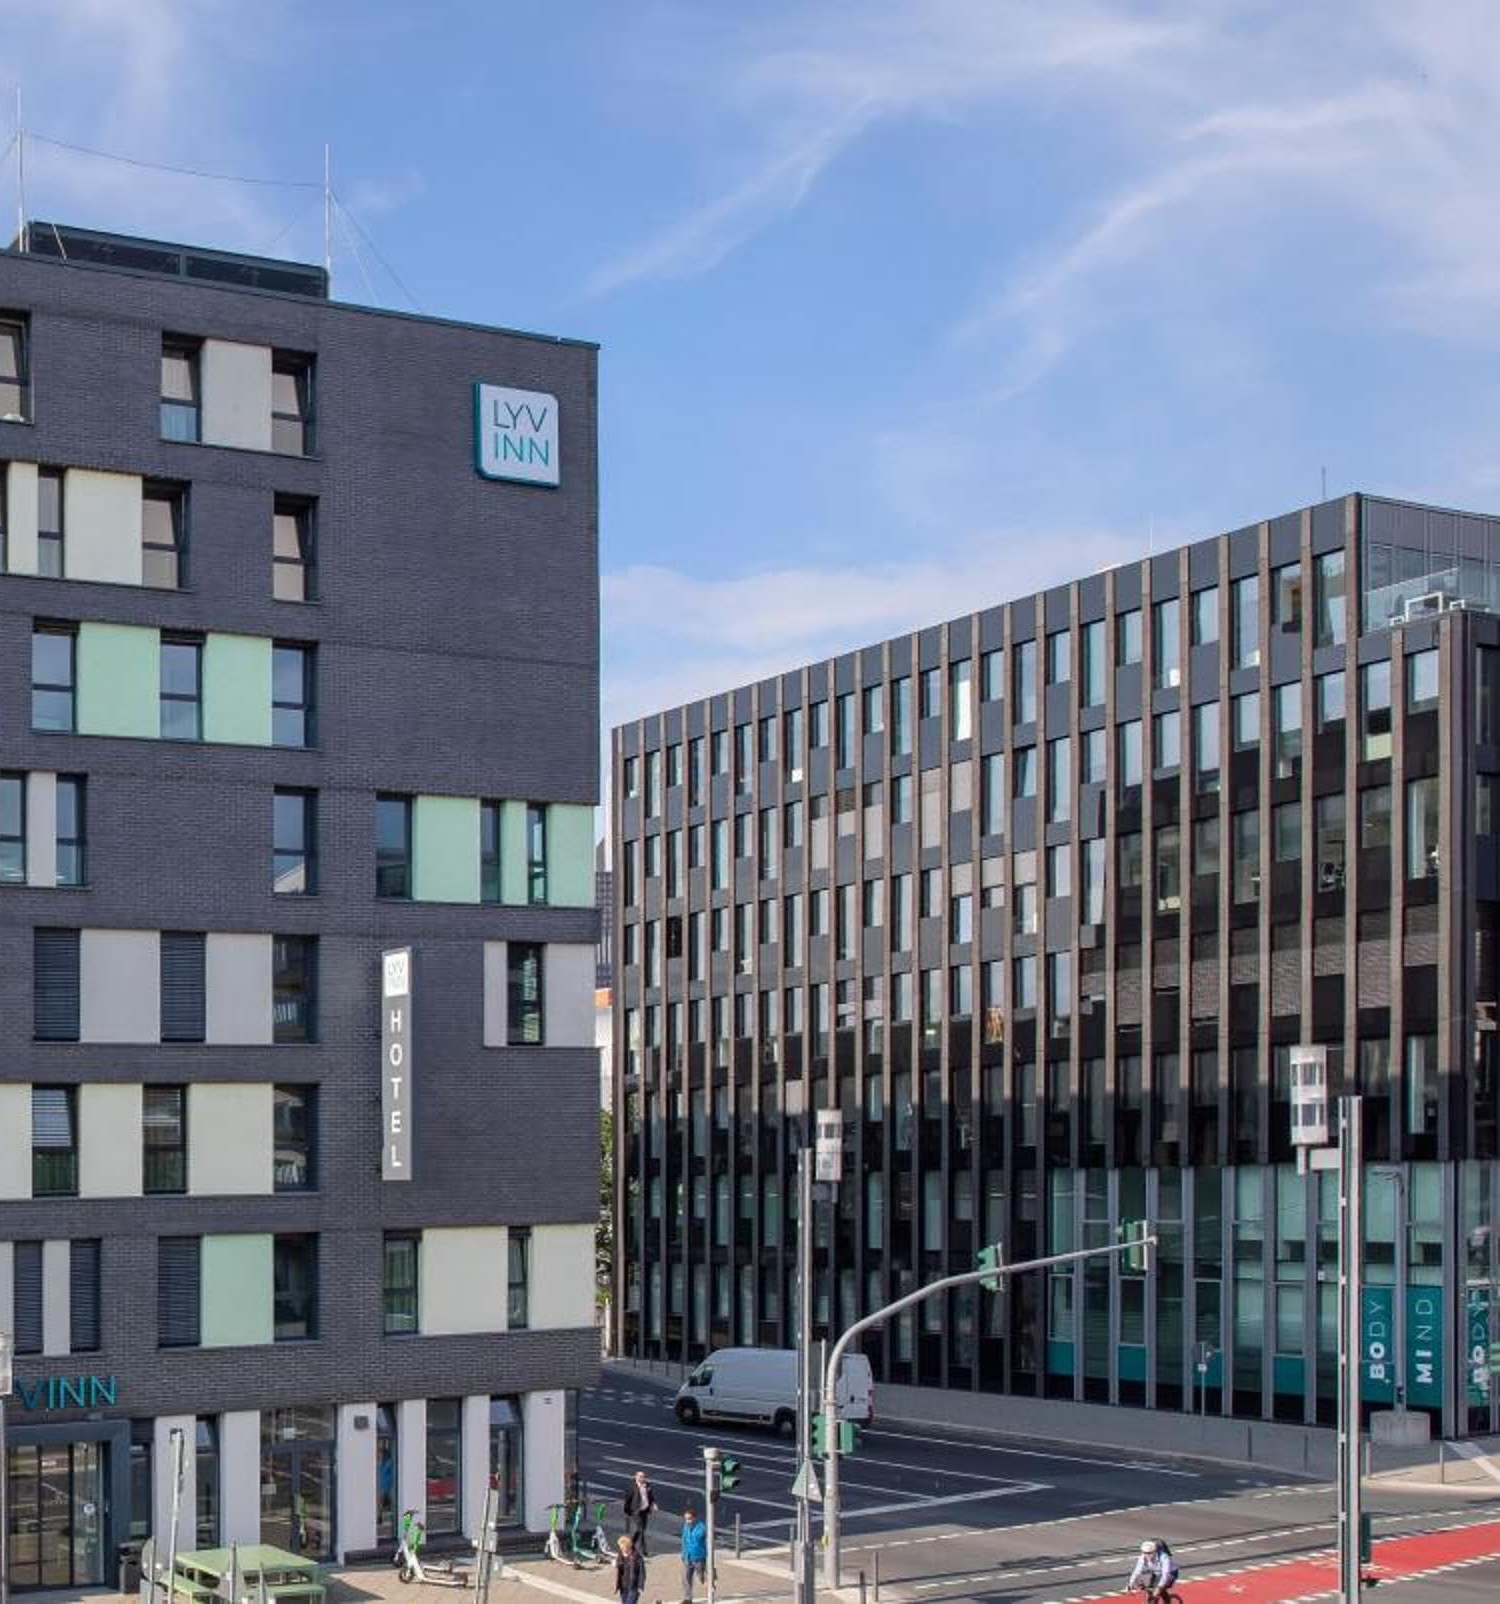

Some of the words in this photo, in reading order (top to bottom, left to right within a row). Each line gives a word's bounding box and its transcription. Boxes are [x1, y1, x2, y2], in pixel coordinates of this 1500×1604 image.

[493, 399, 547, 433] LYV
[494, 432, 548, 466] INN
[390, 1009, 403, 1168] HOTEL
[1369, 1301, 1385, 1380] BODY
[1415, 1299, 1433, 1384] MIND
